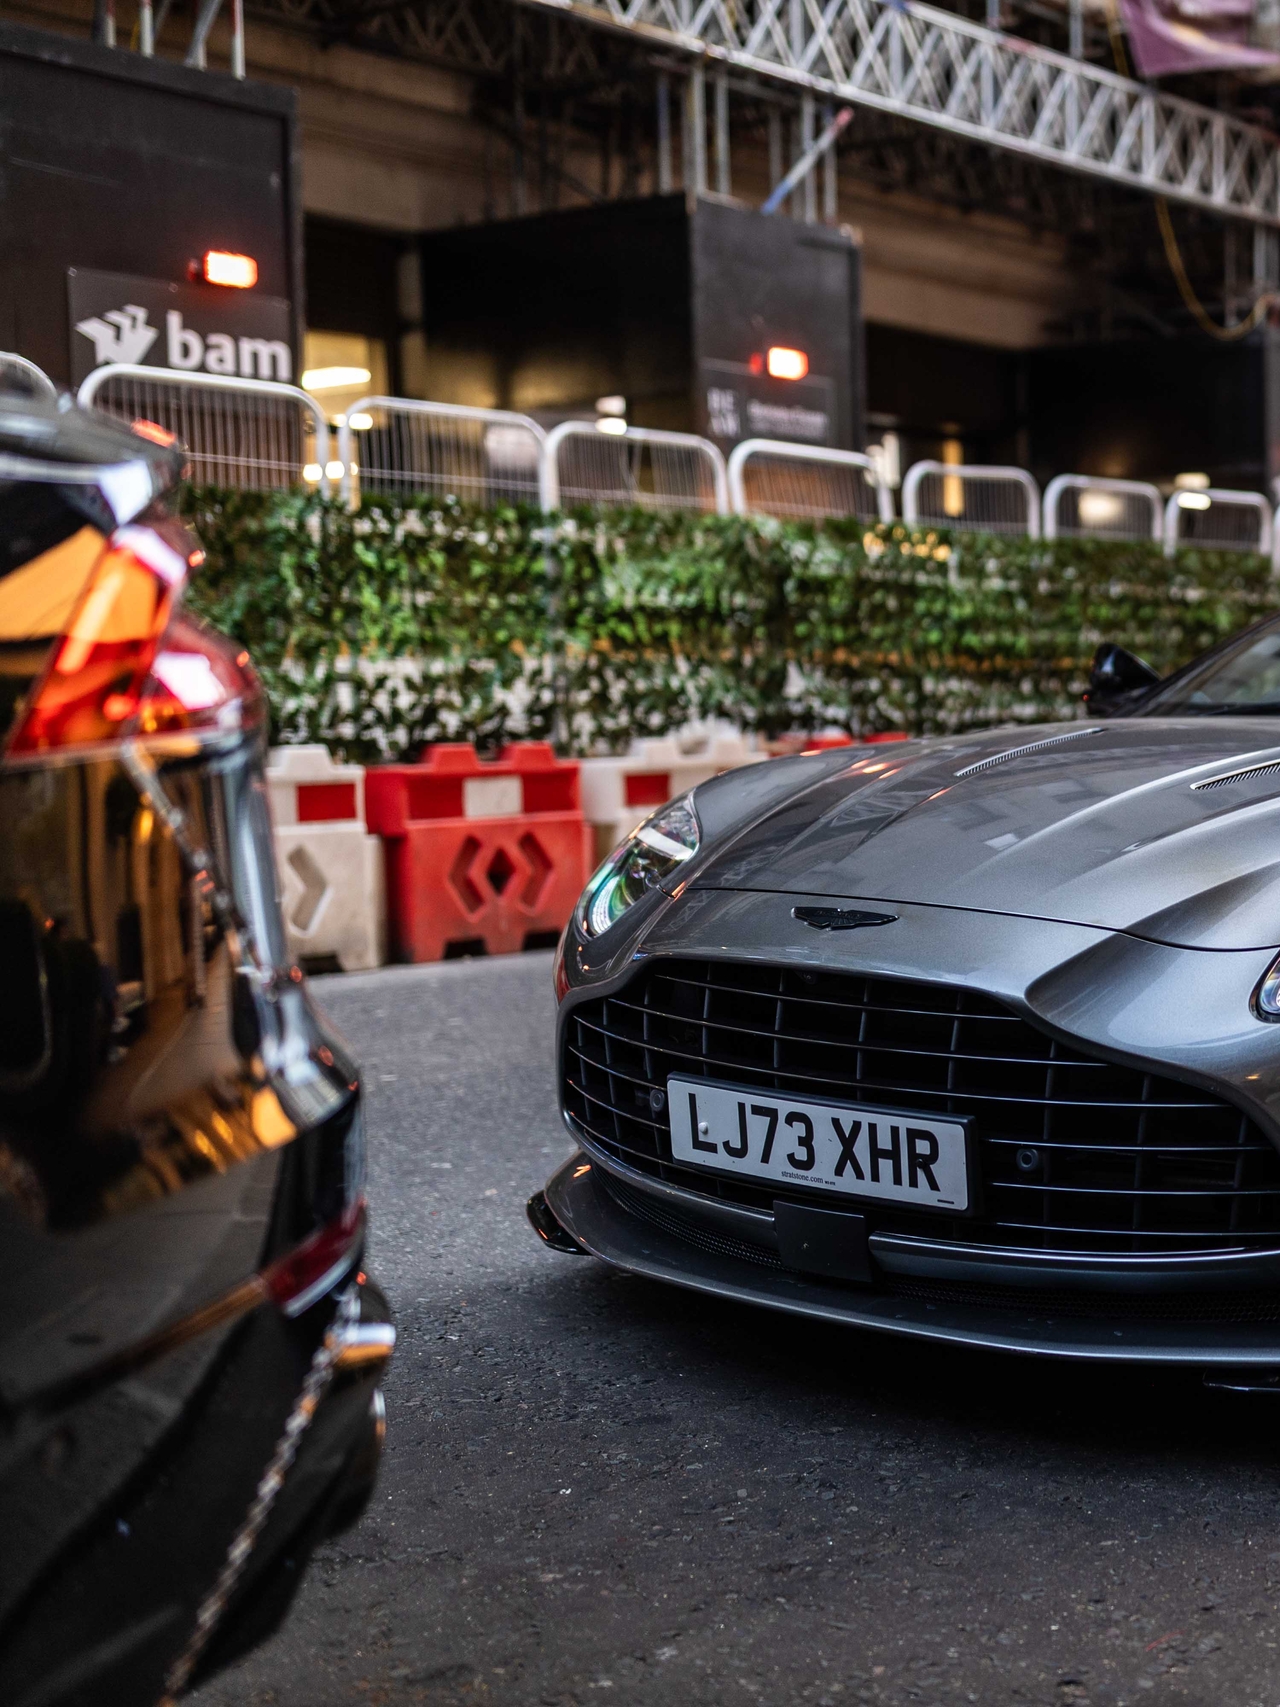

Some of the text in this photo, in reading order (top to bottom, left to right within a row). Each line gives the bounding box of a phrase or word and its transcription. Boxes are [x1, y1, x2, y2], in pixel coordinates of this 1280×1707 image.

[166, 309, 293, 383] bam
[688, 1092, 941, 1193] LJ73 XHR
[781, 1171, 824, 1184] stratstone.com
